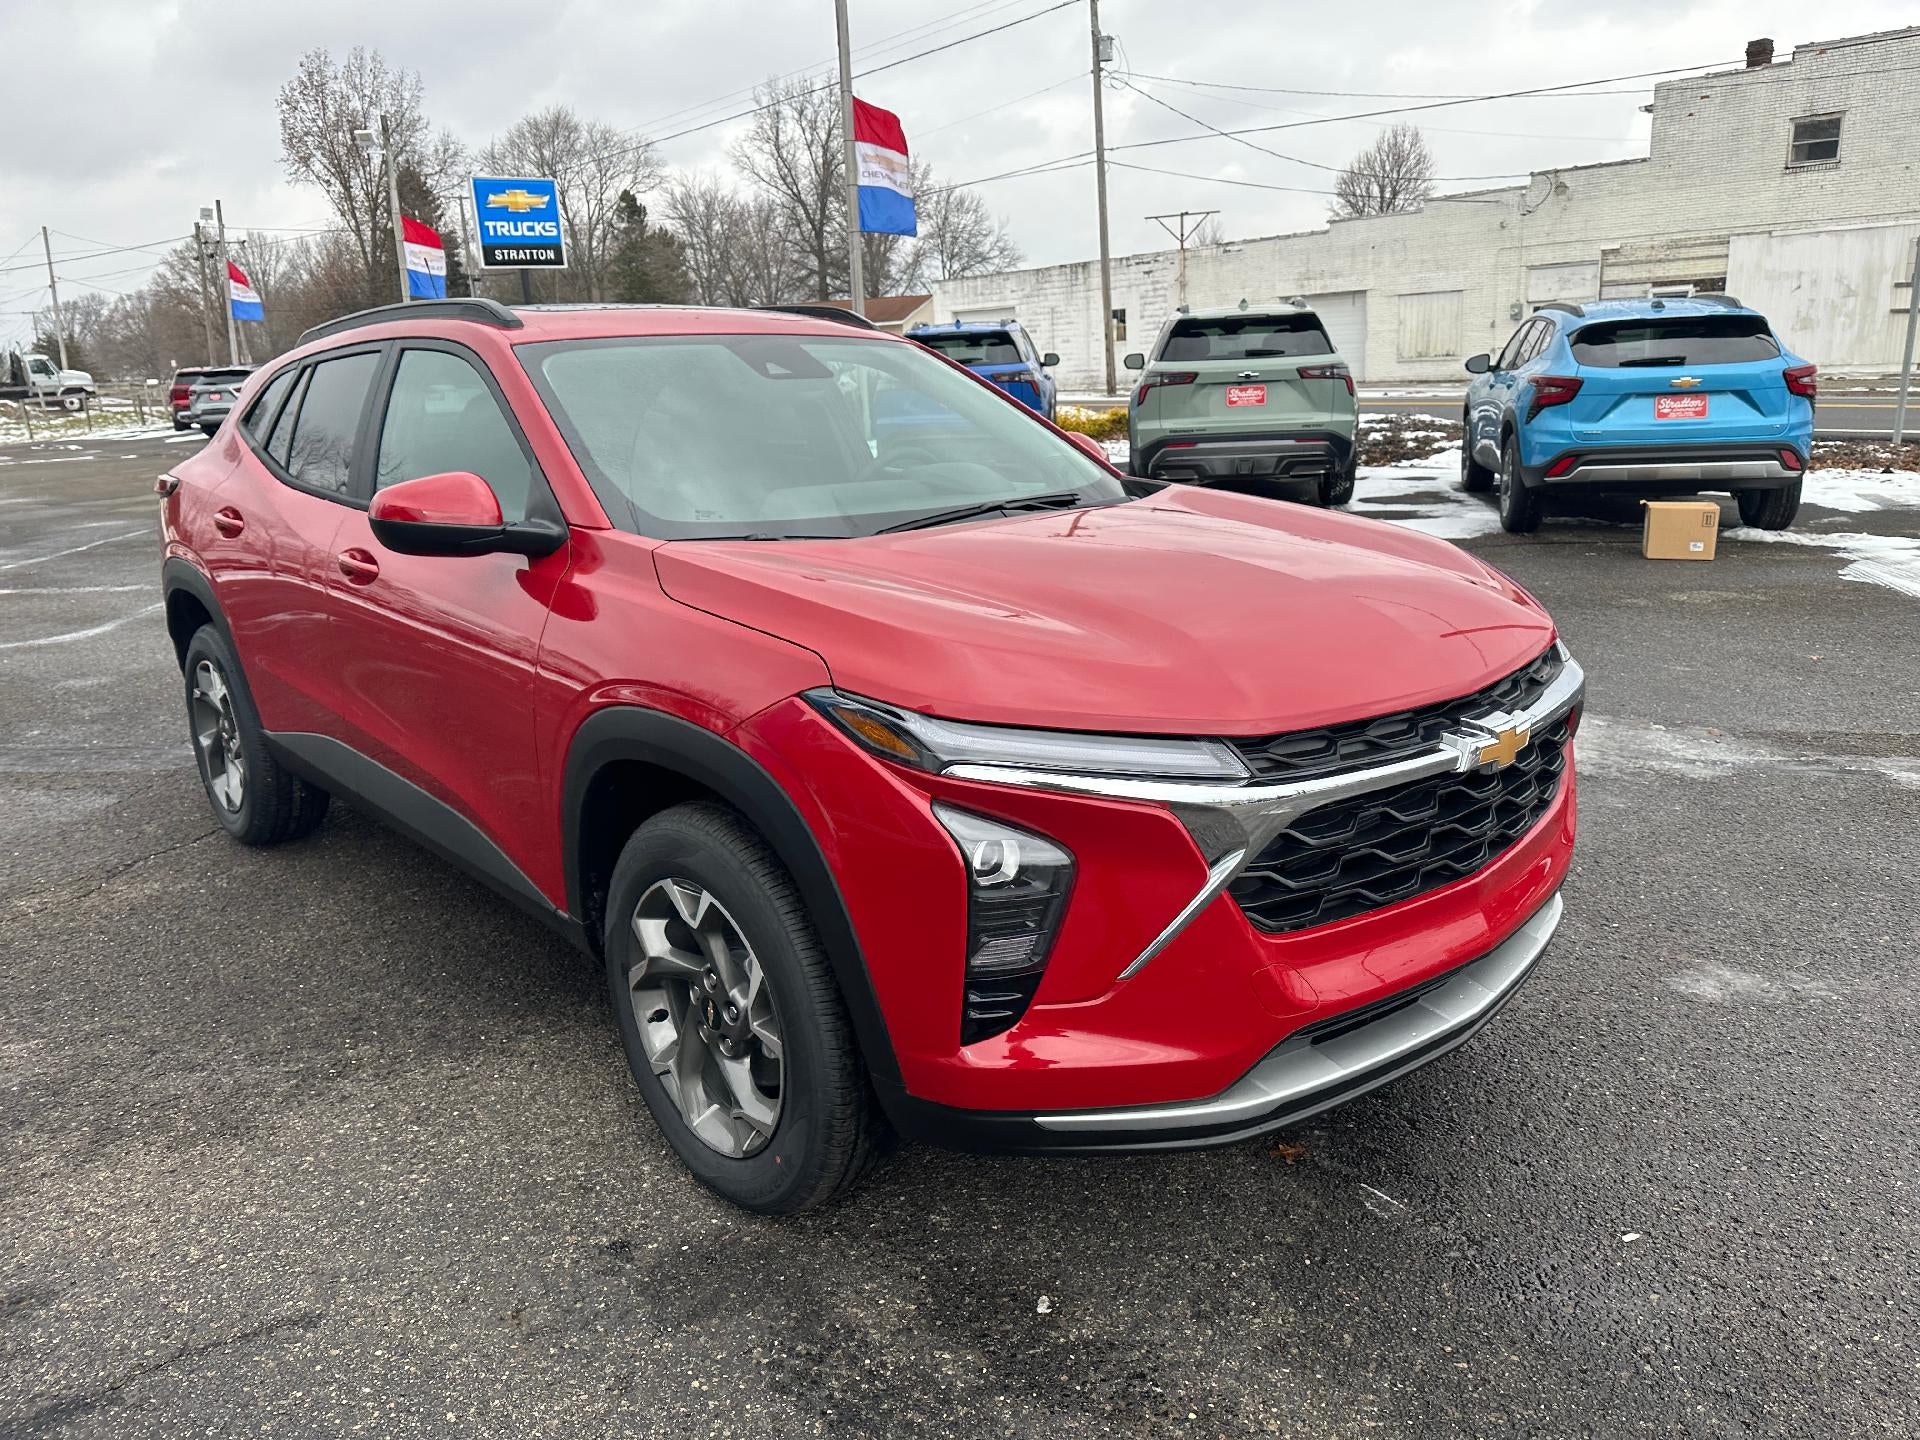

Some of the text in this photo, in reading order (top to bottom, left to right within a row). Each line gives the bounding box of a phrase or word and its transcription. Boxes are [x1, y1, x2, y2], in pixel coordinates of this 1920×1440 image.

[862, 170, 910, 190] CHEVLET
[484, 221, 558, 236] TRUCKS
[494, 249, 555, 260] STRATTON
[1658, 397, 1706, 410] Stratton
